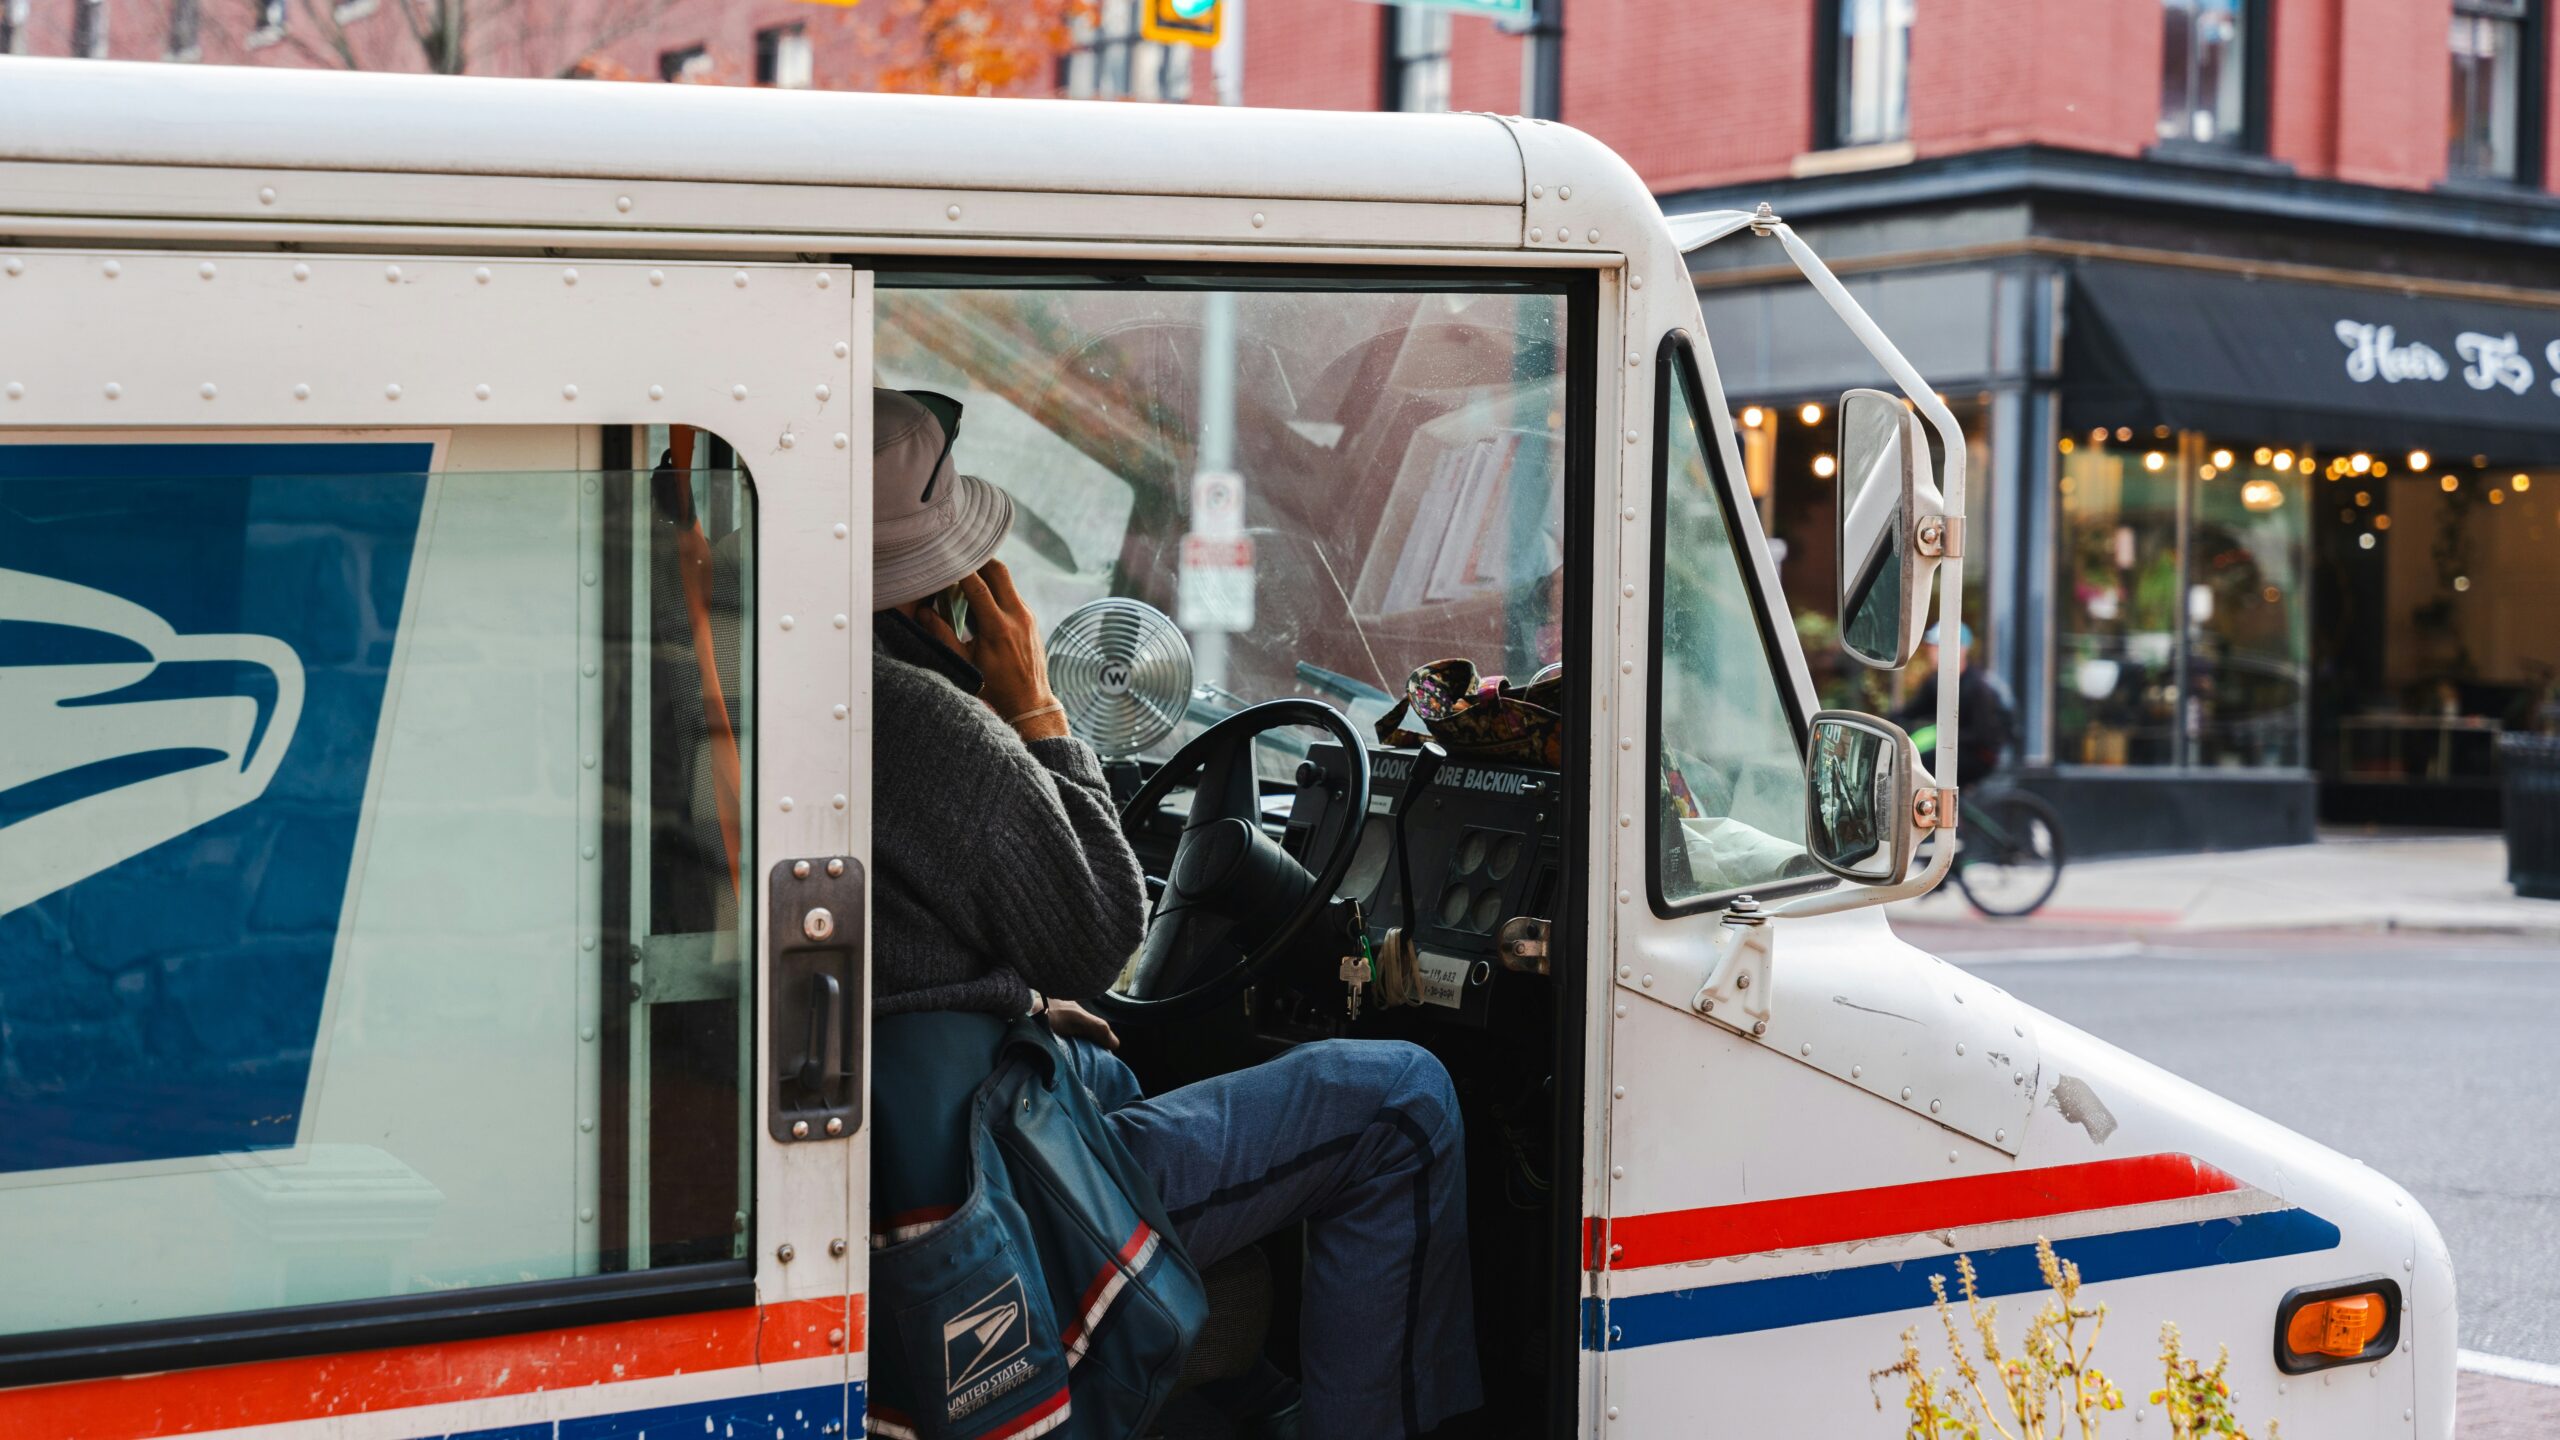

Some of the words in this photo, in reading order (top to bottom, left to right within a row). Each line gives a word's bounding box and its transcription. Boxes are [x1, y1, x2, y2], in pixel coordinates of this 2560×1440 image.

[1107, 671, 1128, 686] W
[1372, 757, 1411, 780] LOOK
[1433, 765, 1466, 788] ORE
[1463, 768, 1529, 795] BACKING
[947, 1379, 990, 1411] UNITED
[990, 1356, 1029, 1387] STATES
[949, 1393, 991, 1424] POSTAL
